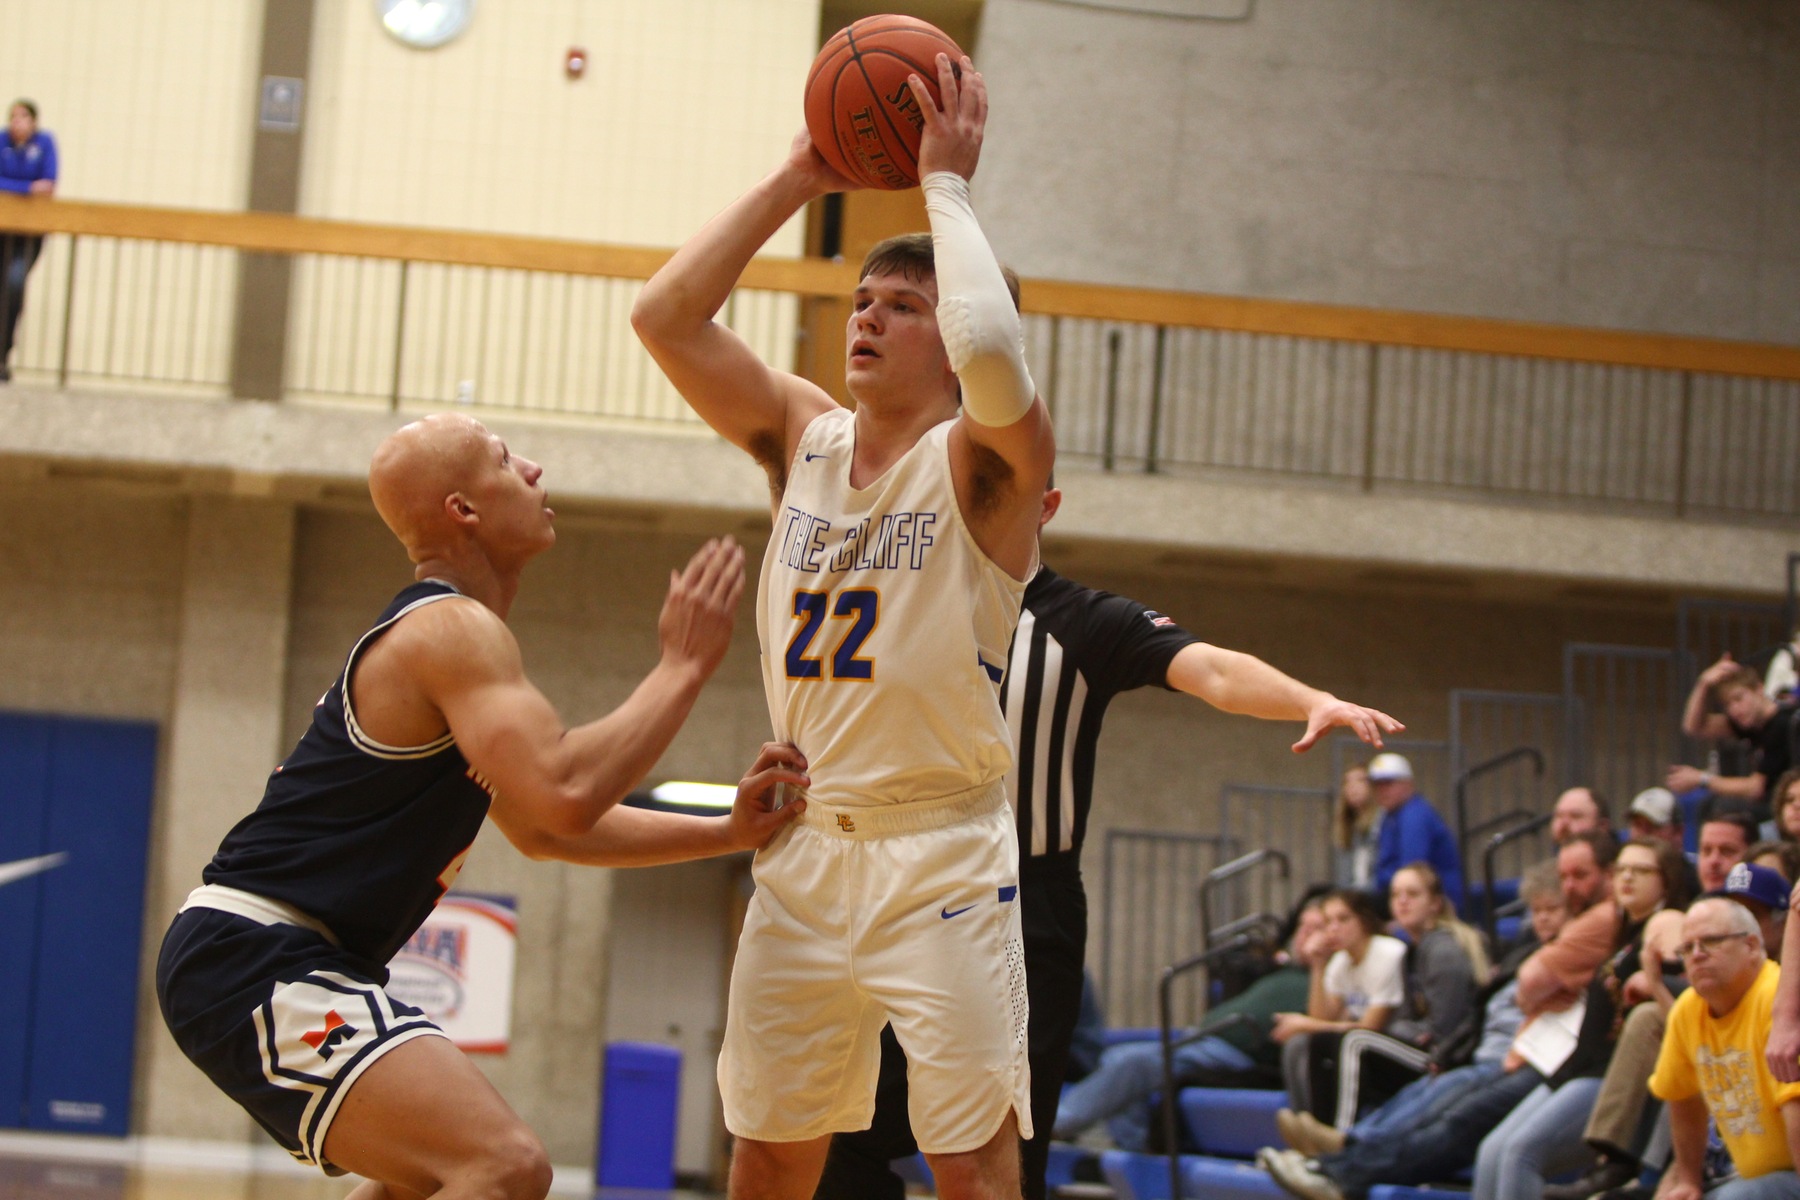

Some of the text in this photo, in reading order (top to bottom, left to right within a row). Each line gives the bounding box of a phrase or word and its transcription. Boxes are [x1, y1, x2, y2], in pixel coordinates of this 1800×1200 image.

[780, 506, 936, 573] THE CLIFF
[785, 586, 881, 682] 22
